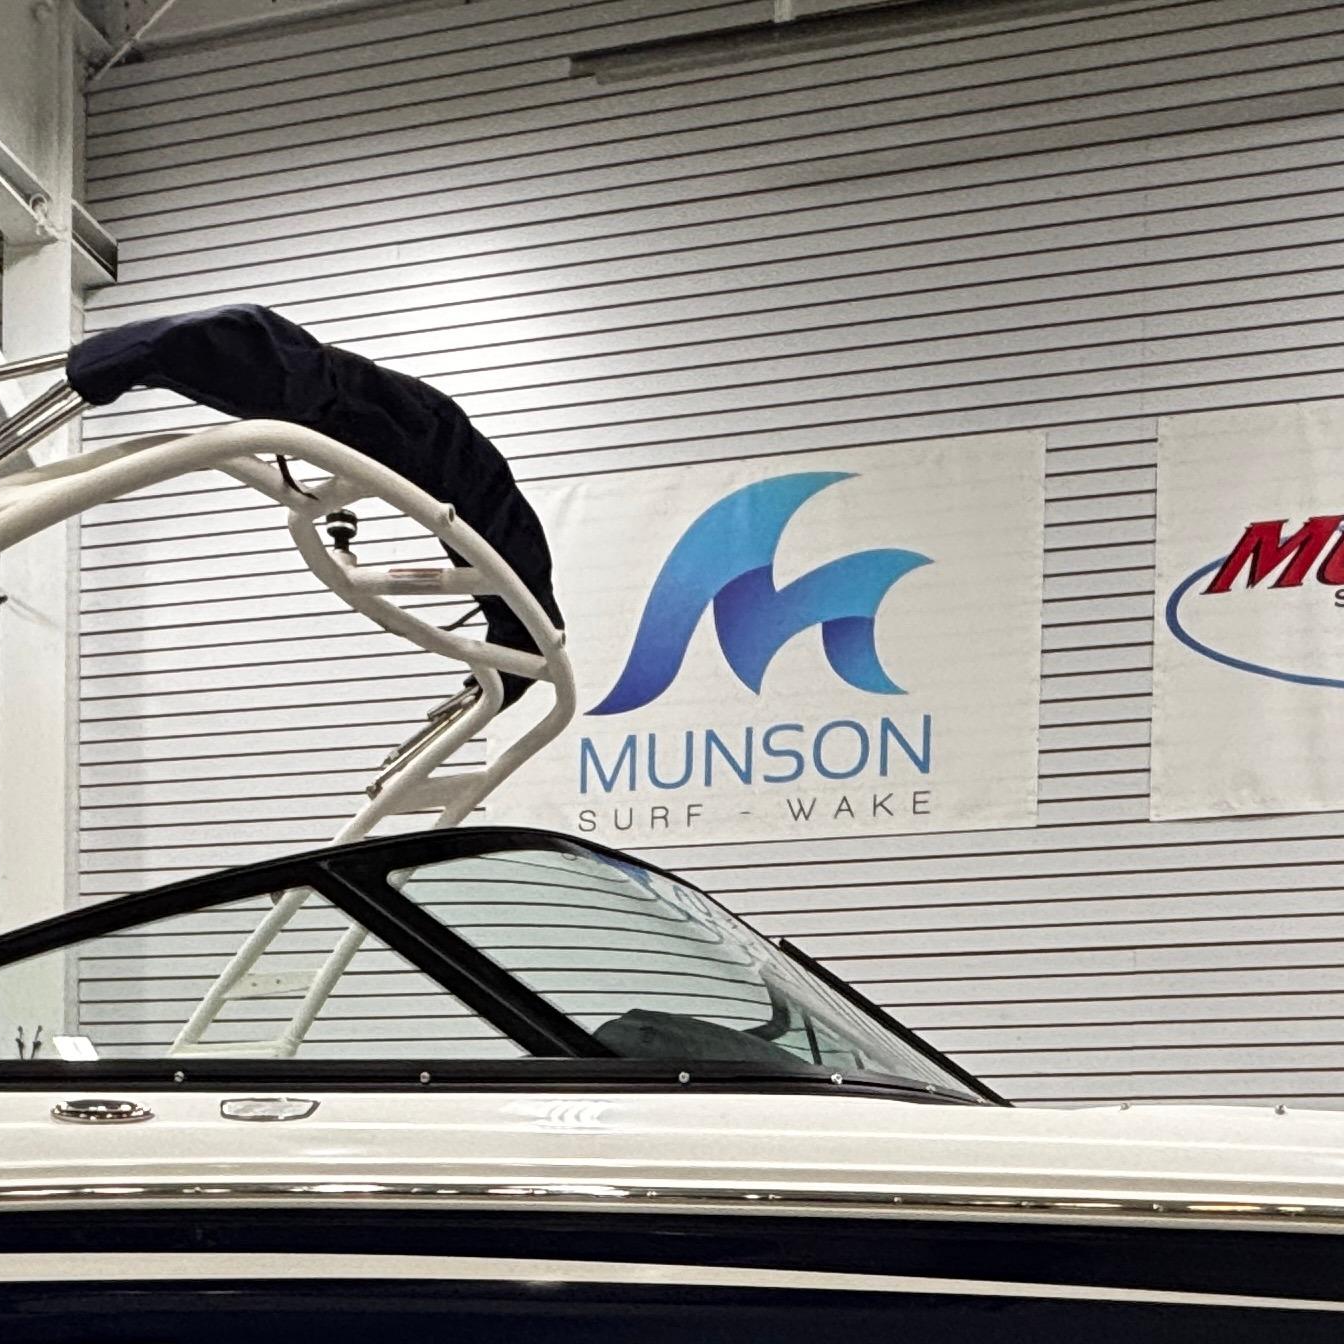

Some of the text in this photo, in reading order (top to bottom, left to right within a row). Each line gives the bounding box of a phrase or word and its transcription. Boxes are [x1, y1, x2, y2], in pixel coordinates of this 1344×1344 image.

[579, 714, 933, 795] MUNSON
[578, 804, 703, 833] SURF
[787, 790, 932, 821] WAKE
